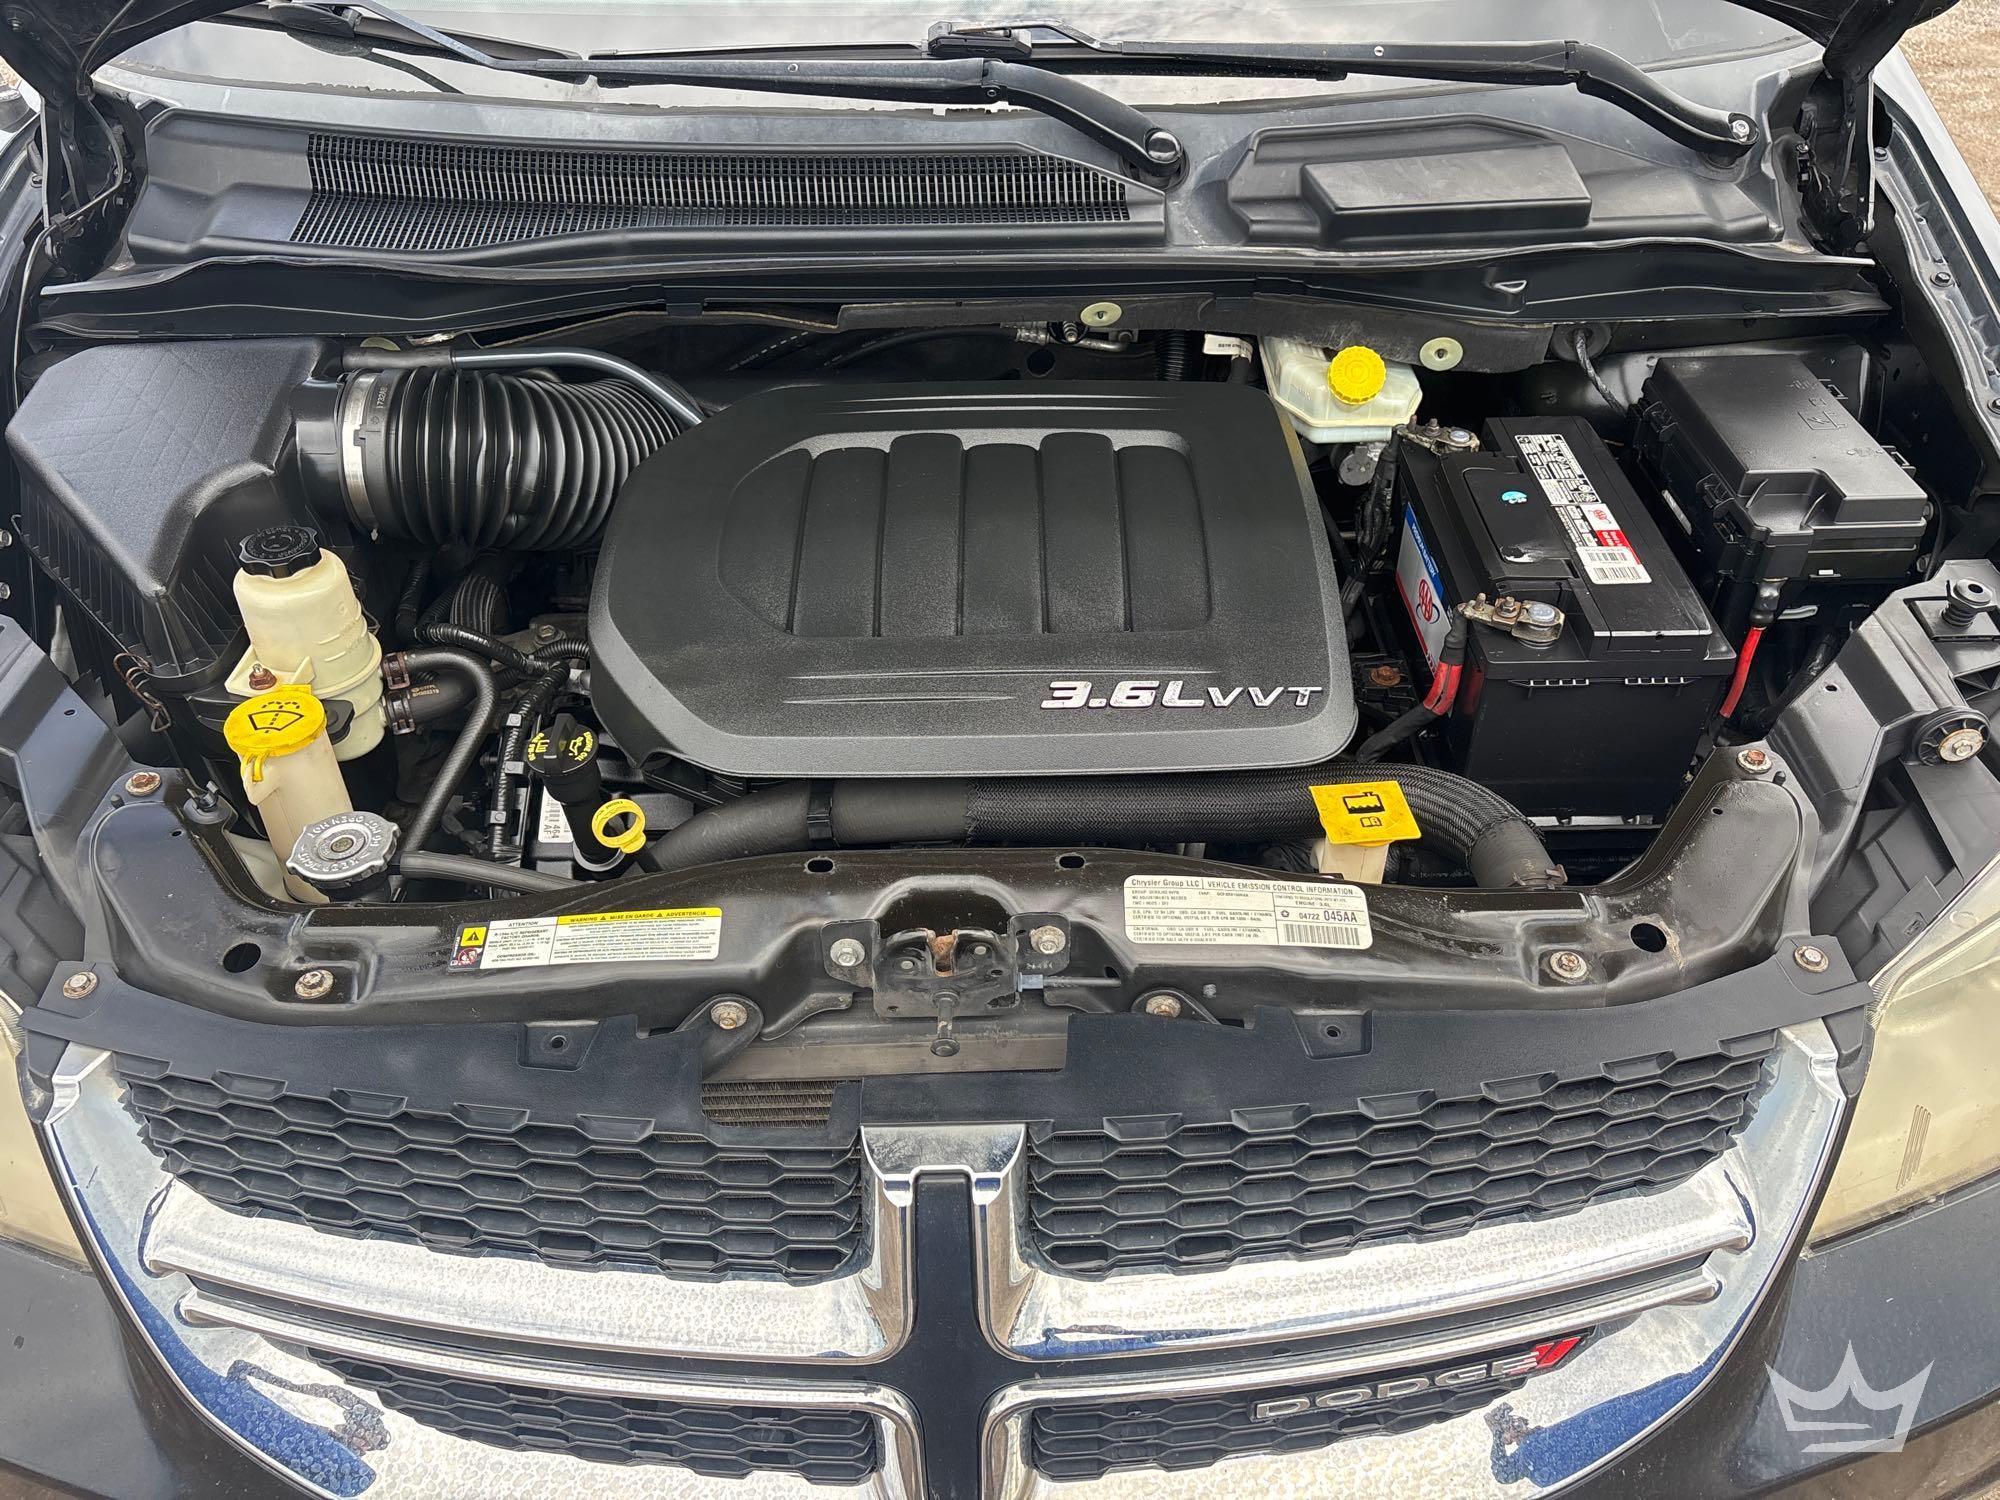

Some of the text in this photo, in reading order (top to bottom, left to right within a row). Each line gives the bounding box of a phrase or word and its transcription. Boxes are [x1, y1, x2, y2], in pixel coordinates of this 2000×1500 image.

[1041, 681, 1323, 709] 3.6L VVT
[1131, 878, 1161, 886] Chrysler
[1163, 879, 1184, 887] Group
[1208, 881, 1236, 889] VEHICLE
[1237, 882, 1271, 890] EMISSION
[1272, 884, 1304, 892] CONTROL
[1306, 886, 1353, 895] INFORMATION
[1298, 910, 1358, 923] 04722 045AA
[1256, 1351, 1539, 1419] DODGE
